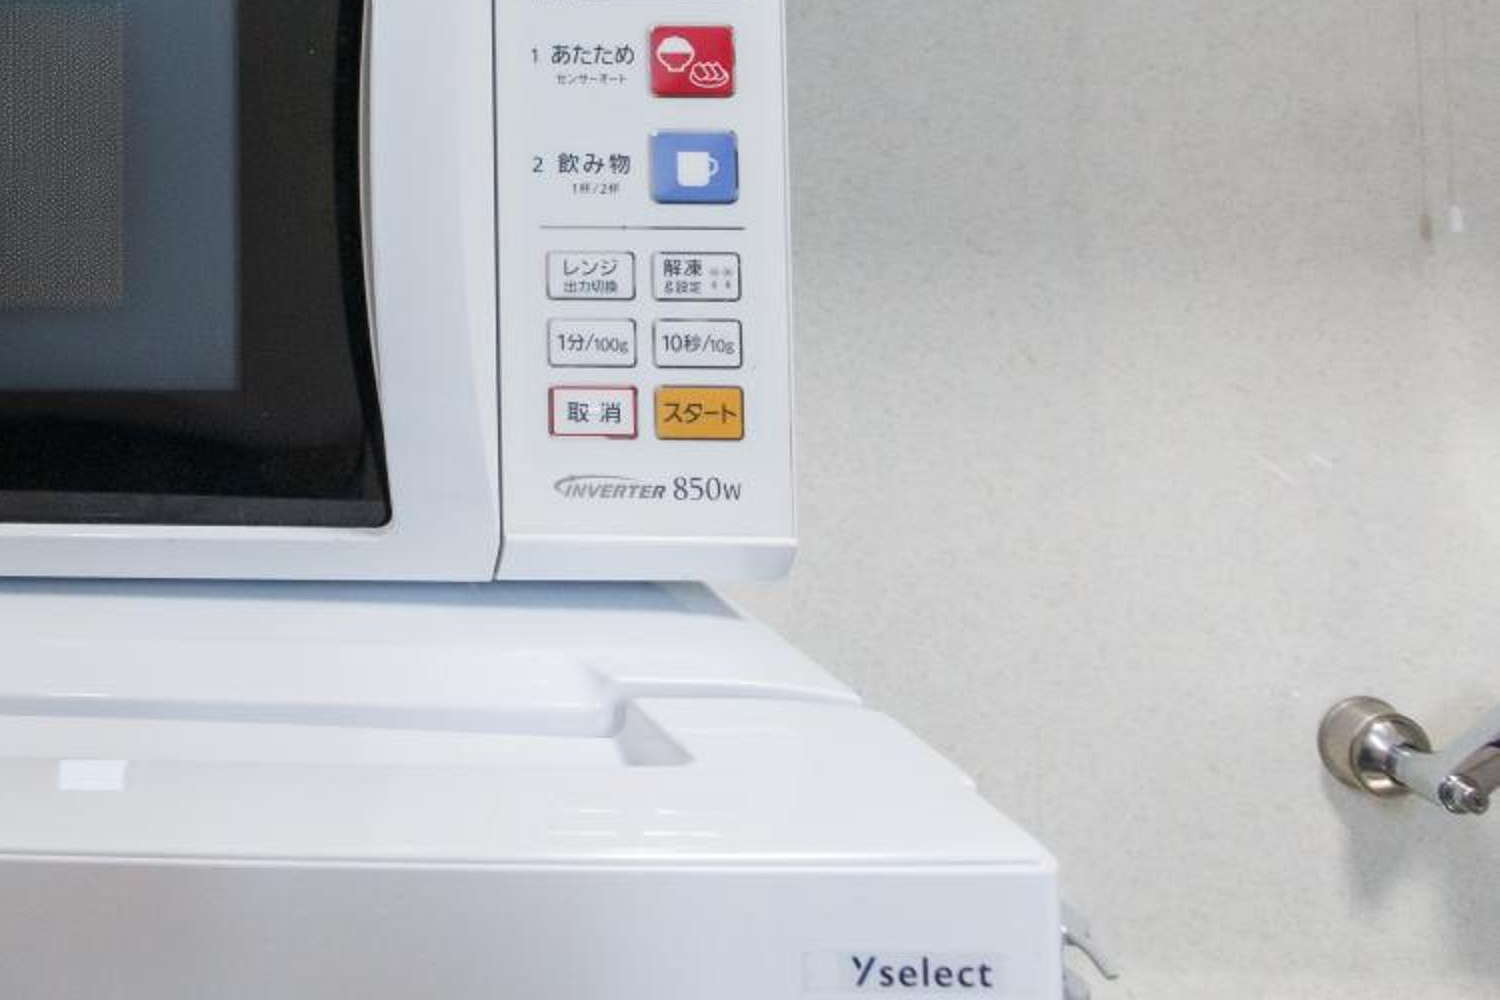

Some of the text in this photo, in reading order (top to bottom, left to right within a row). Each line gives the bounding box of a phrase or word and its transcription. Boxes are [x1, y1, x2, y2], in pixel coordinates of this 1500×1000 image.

[550, 44, 635, 65] あたため
[557, 74, 627, 85] センサーオート
[532, 153, 631, 175] 2 飲み物
[563, 259, 618, 277] レンジ
[663, 259, 703, 277] 解凍
[558, 333, 629, 354] 1分/100g
[662, 334, 736, 355] 10秒/10g
[663, 402, 738, 424] スタート
[564, 483, 667, 499] INVERTER
